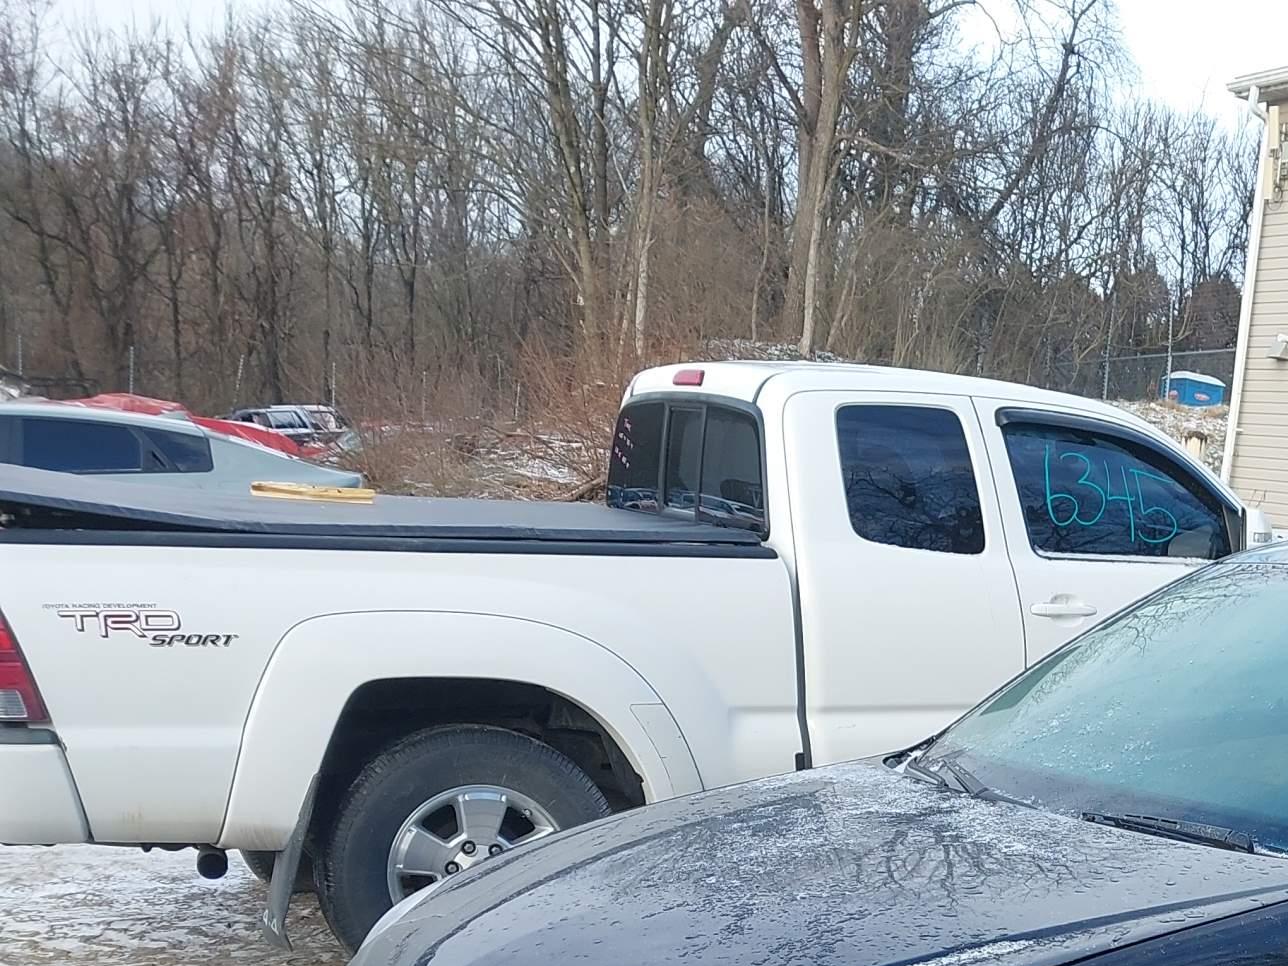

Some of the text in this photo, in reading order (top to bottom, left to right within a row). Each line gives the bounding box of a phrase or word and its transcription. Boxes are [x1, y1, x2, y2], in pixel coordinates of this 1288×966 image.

[1044, 444, 1177, 543] 6345
[57, 610, 182, 638] TRD
[150, 634, 235, 648] SPORT
